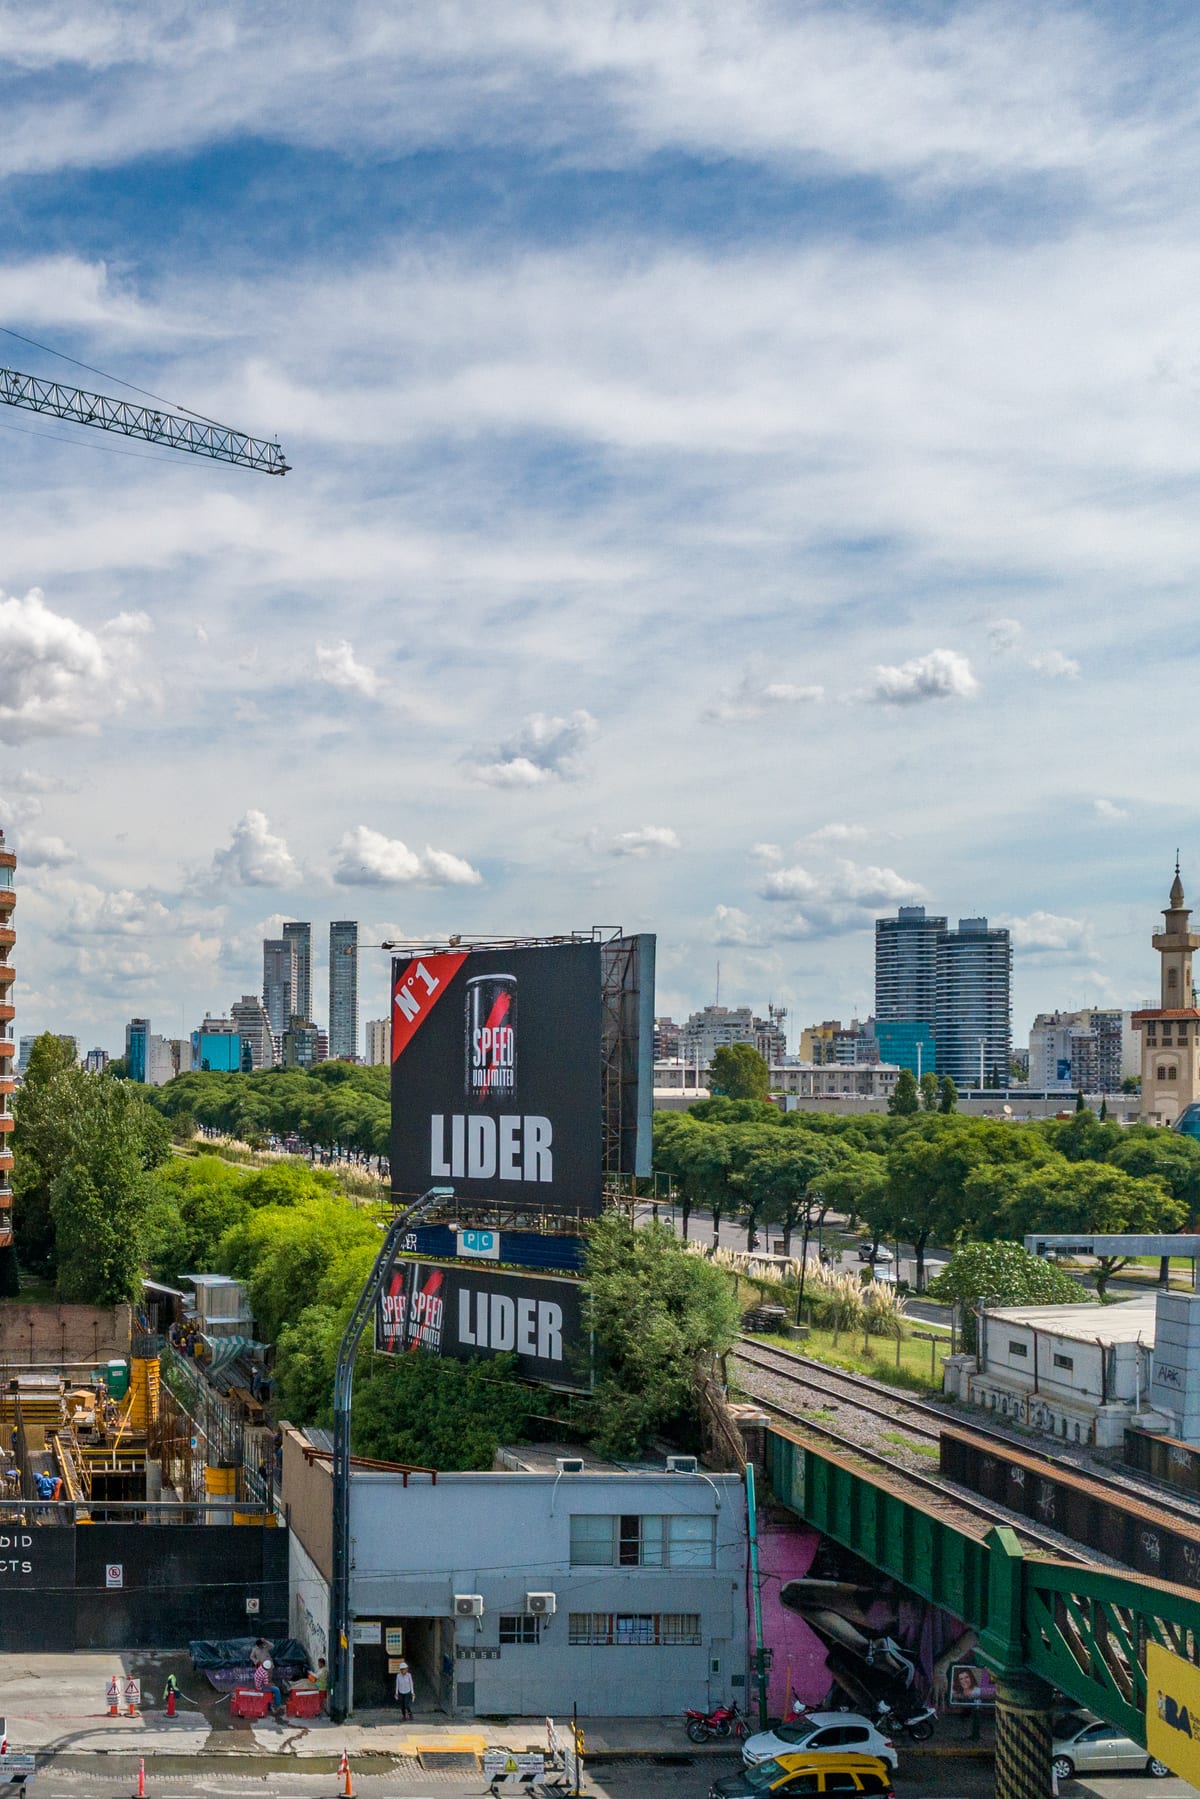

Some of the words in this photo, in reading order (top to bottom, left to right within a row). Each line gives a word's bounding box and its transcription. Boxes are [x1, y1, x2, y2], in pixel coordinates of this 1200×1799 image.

[472, 1026, 514, 1067] SPEED
[472, 1068, 514, 1087] UNLIMITED
[430, 1114, 553, 1183] LIDER
[409, 1291, 443, 1330] SPEED
[458, 1288, 563, 1361] LIDER
[460, 1651, 497, 1659] 3858
